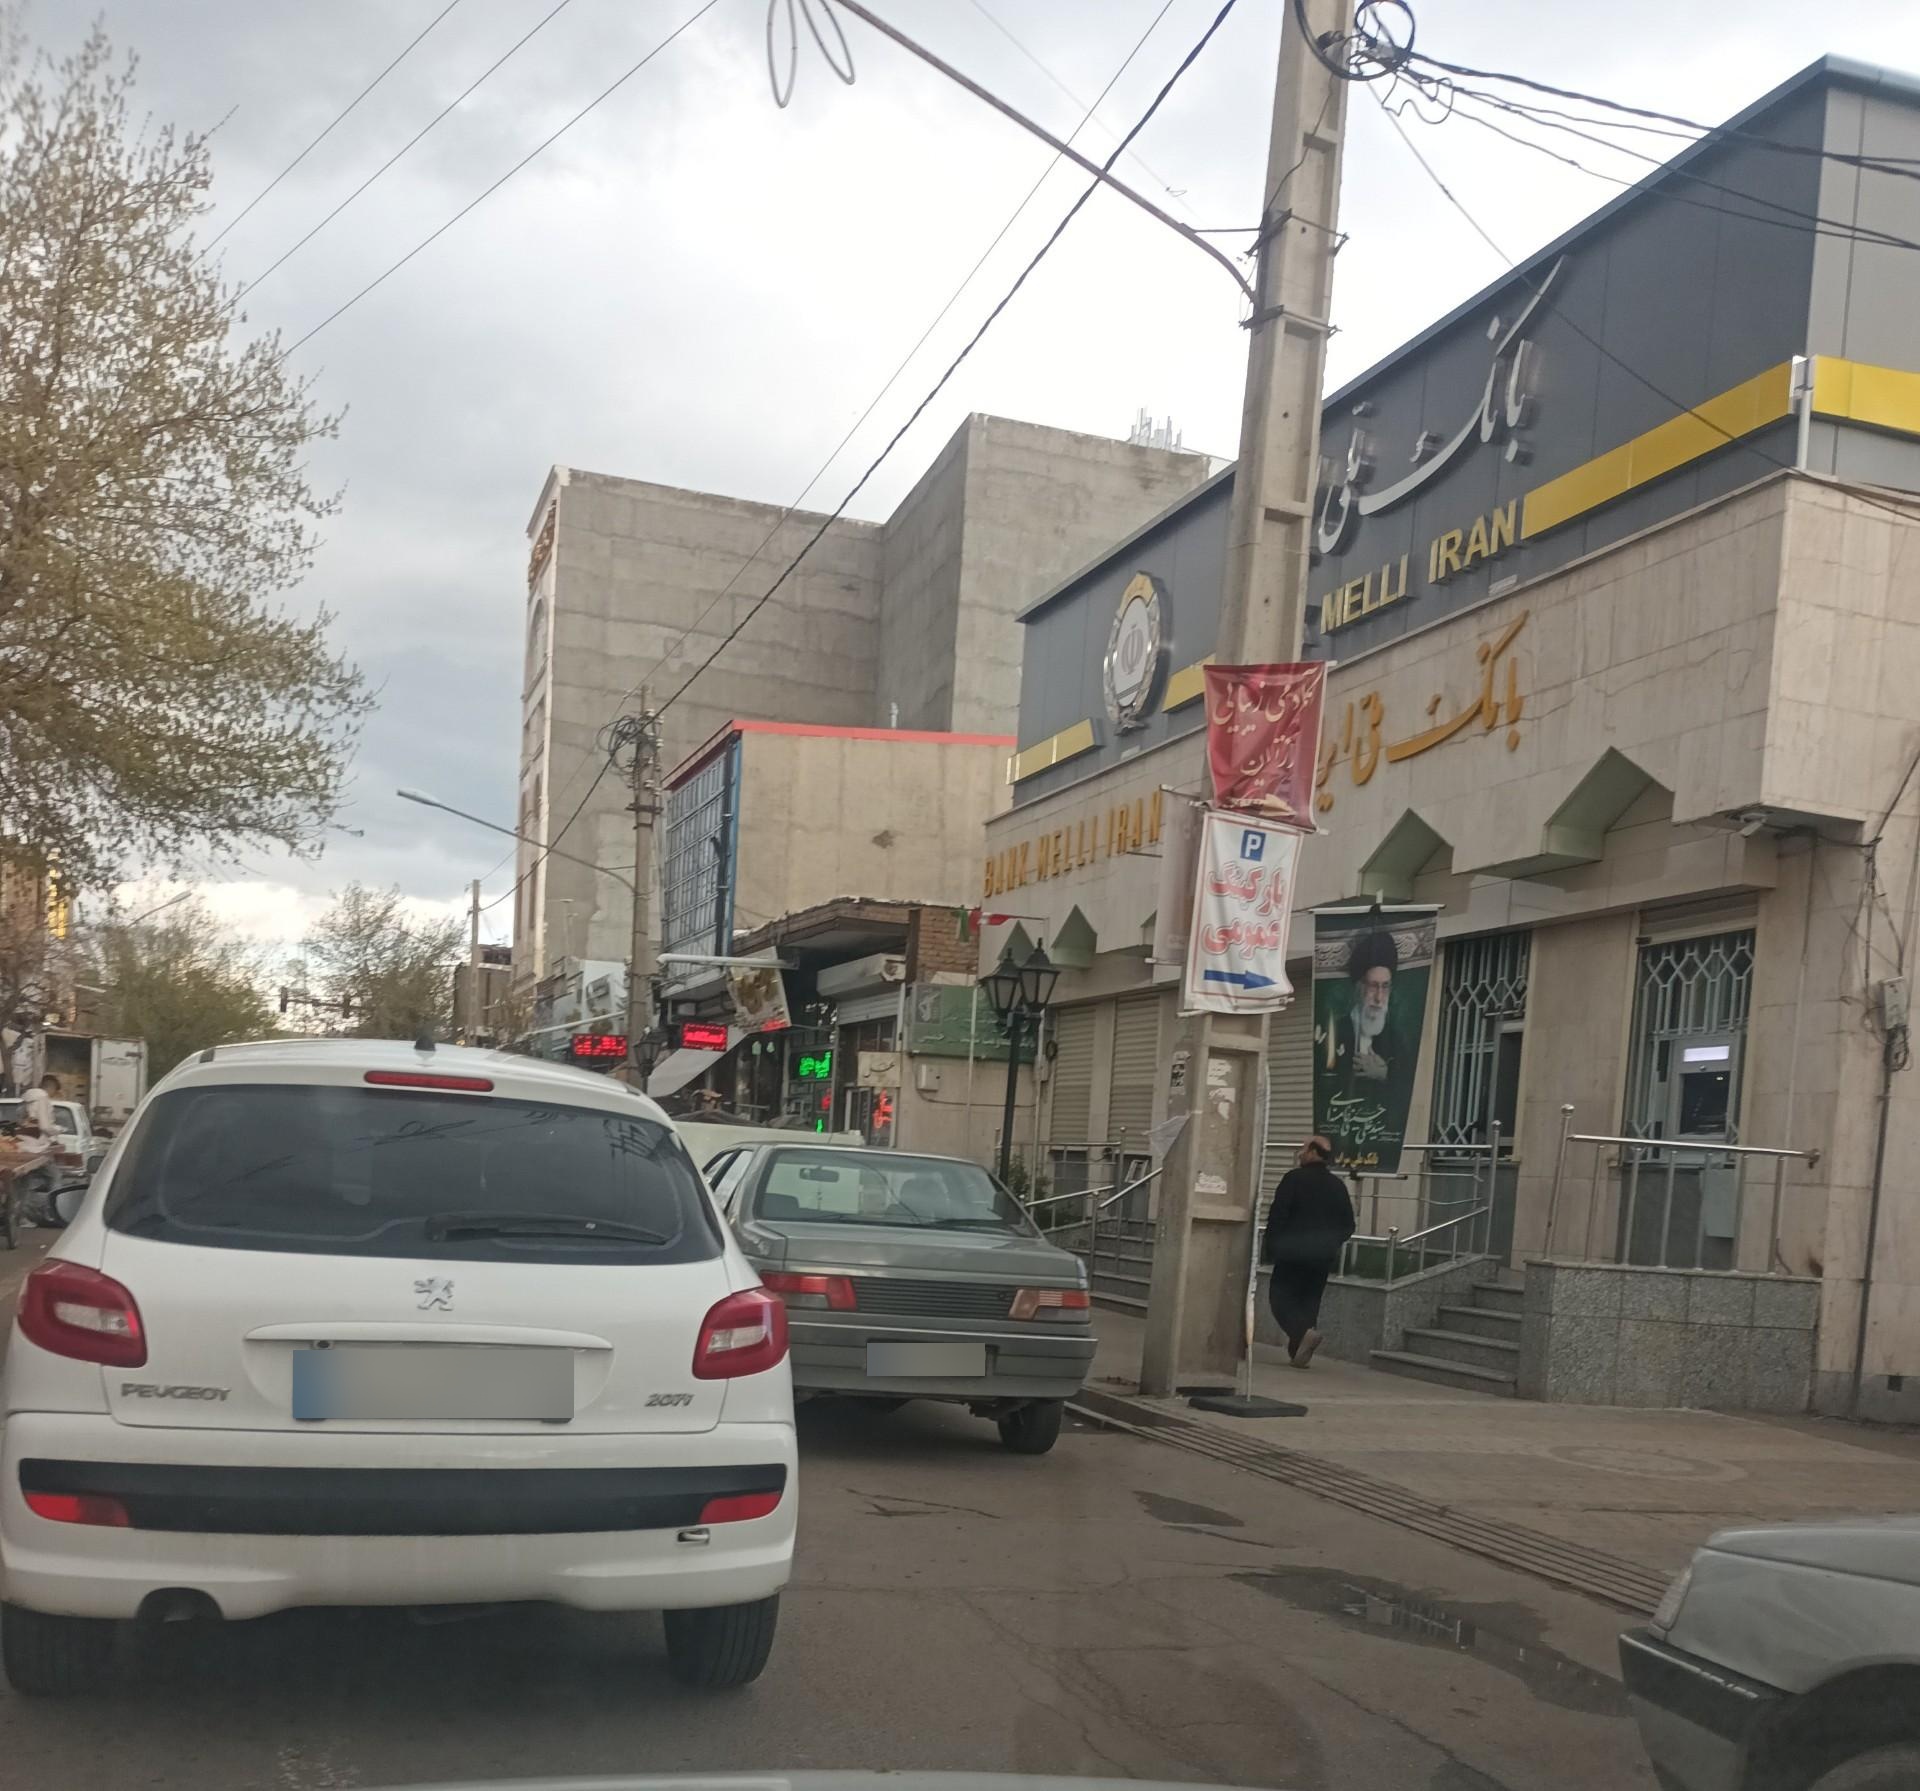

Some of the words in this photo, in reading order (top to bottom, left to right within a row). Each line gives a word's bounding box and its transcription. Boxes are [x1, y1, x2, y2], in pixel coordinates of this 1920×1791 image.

[1358, 254, 1564, 516] بانک
[1319, 552, 1411, 635] MELLI
[1428, 497, 1521, 585] IRAN
[1386, 609, 1529, 763] بانک
[984, 840, 1029, 898] BANK
[1037, 814, 1098, 881] MELLI
[1106, 790, 1163, 858] IRAN
[1244, 834, 1262, 858] P
[1206, 861, 1286, 916] پارکینگ
[1202, 917, 1281, 961] عمومی
[120, 1382, 232, 1402] PEUGEOT
